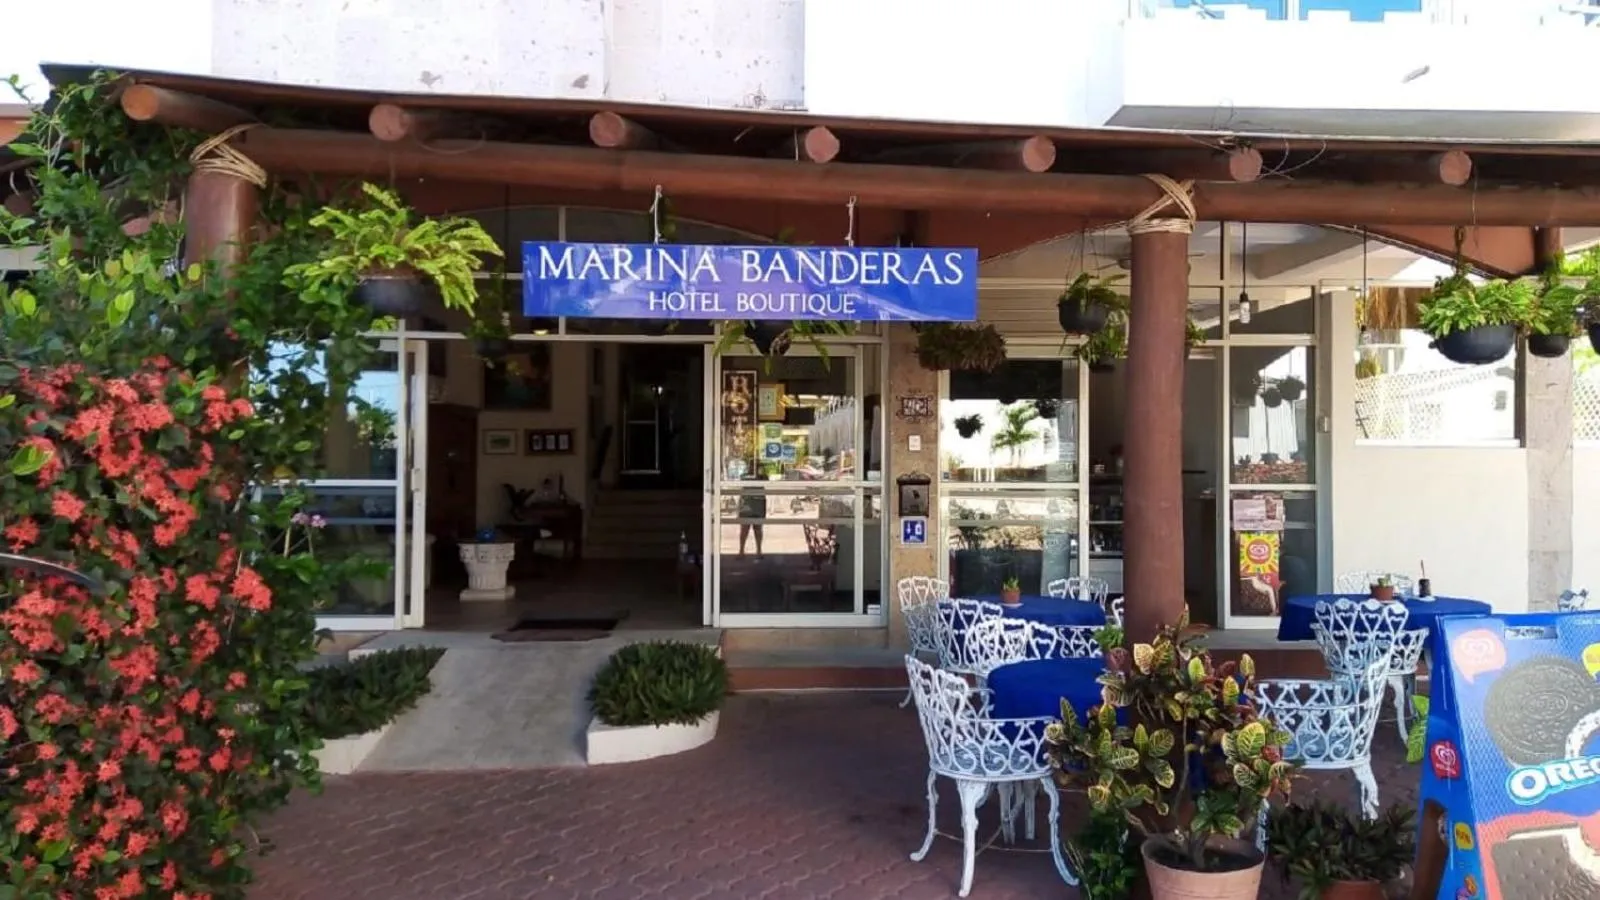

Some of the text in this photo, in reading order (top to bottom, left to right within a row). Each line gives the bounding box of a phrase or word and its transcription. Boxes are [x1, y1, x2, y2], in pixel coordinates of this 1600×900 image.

[538, 245, 965, 286] MARINA BANDERAS
[649, 290, 857, 316] HOTEL BOUTIQUE
